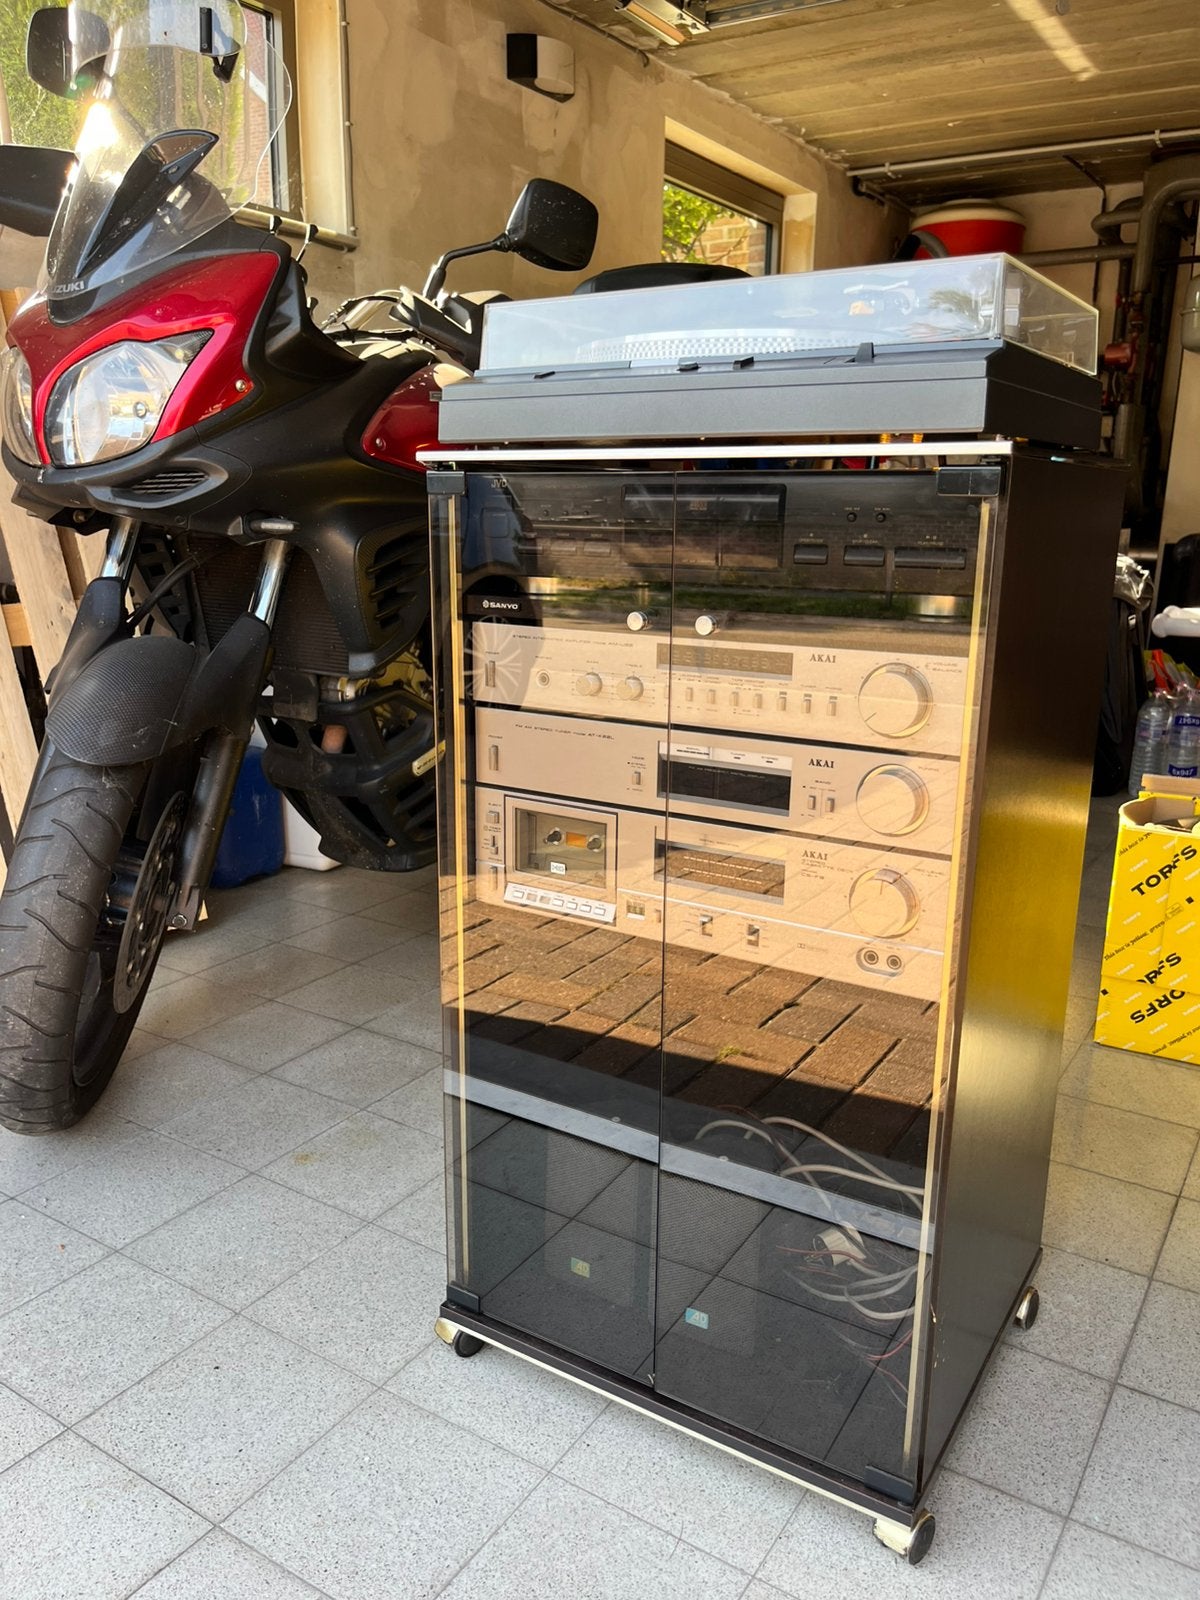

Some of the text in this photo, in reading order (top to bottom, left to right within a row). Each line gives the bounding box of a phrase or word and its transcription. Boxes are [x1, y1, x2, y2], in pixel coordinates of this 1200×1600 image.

[50, 280, 85, 293] UZUKI
[490, 601, 519, 610] SANYO
[809, 653, 837, 664] AKAI
[808, 757, 836, 769] AKAI
[801, 850, 828, 861] AKAI
[1131, 844, 1197, 896] TORFS
